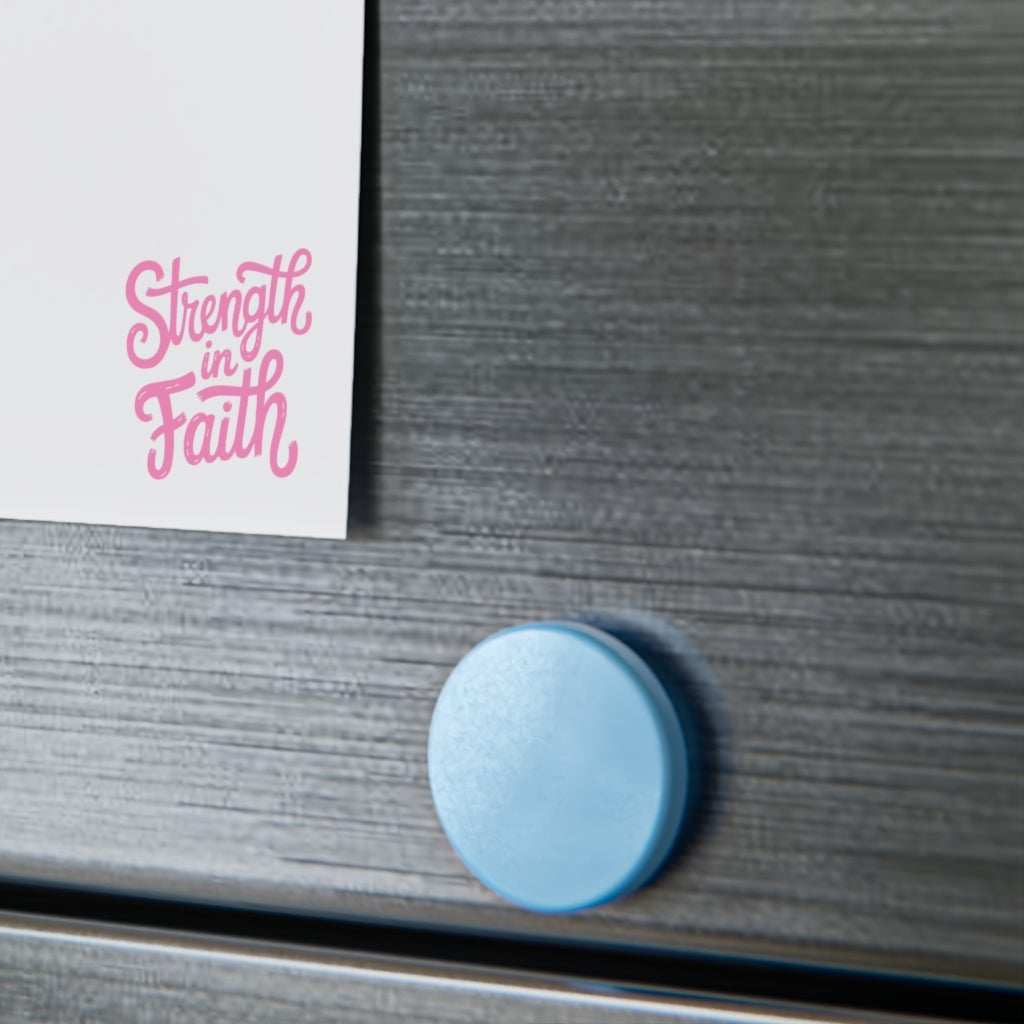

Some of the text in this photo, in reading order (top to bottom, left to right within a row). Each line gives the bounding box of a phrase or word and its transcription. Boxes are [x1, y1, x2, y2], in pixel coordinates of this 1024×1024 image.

[125, 247, 313, 369] Strength
[201, 340, 239, 380] in
[134, 348, 299, 480] Faith
